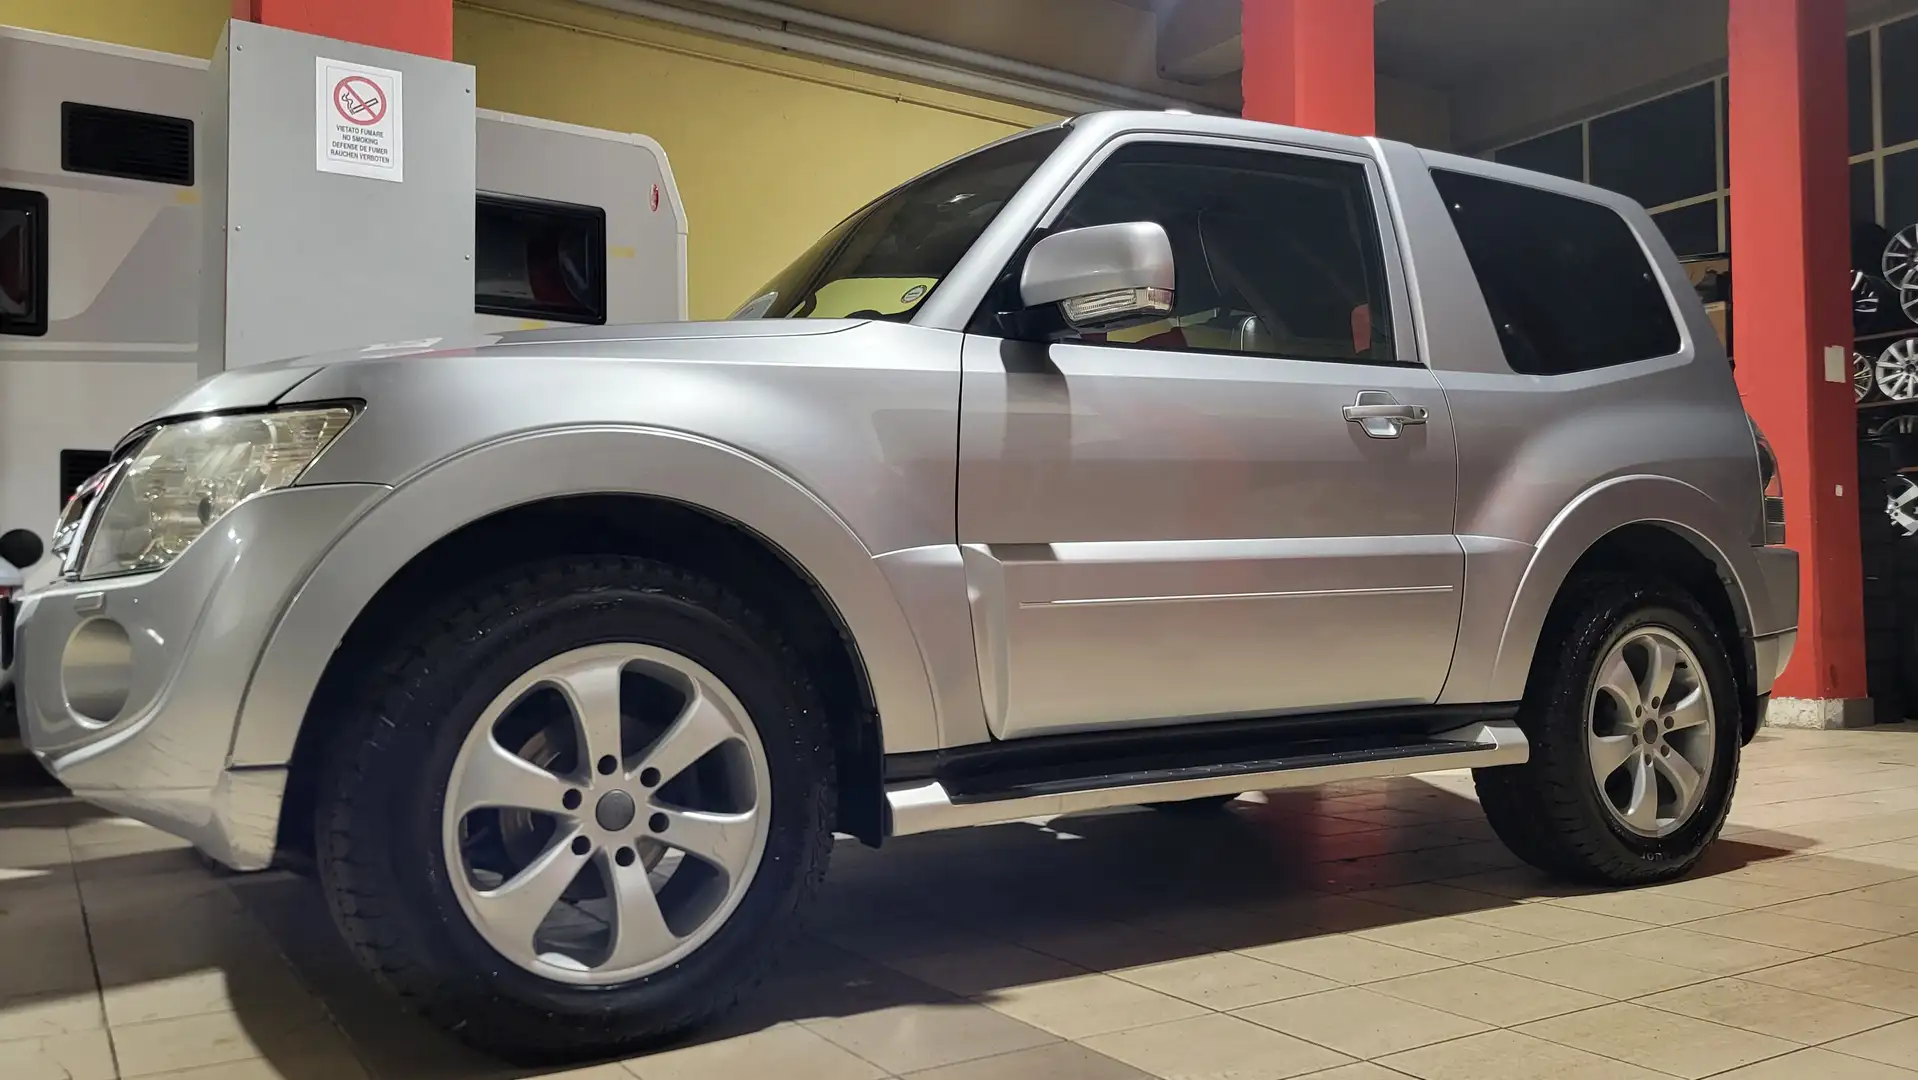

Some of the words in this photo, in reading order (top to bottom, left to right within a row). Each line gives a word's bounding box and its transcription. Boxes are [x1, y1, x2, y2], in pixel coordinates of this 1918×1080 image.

[336, 124, 360, 134] VIETATO
[361, 128, 384, 138] FUMARE
[352, 135, 379, 145] SMOKING
[332, 141, 358, 150] DEFENSE
[369, 146, 388, 155] FUMER
[331, 149, 358, 159] RAUCHEN
[359, 153, 390, 163] VERBOTEN
